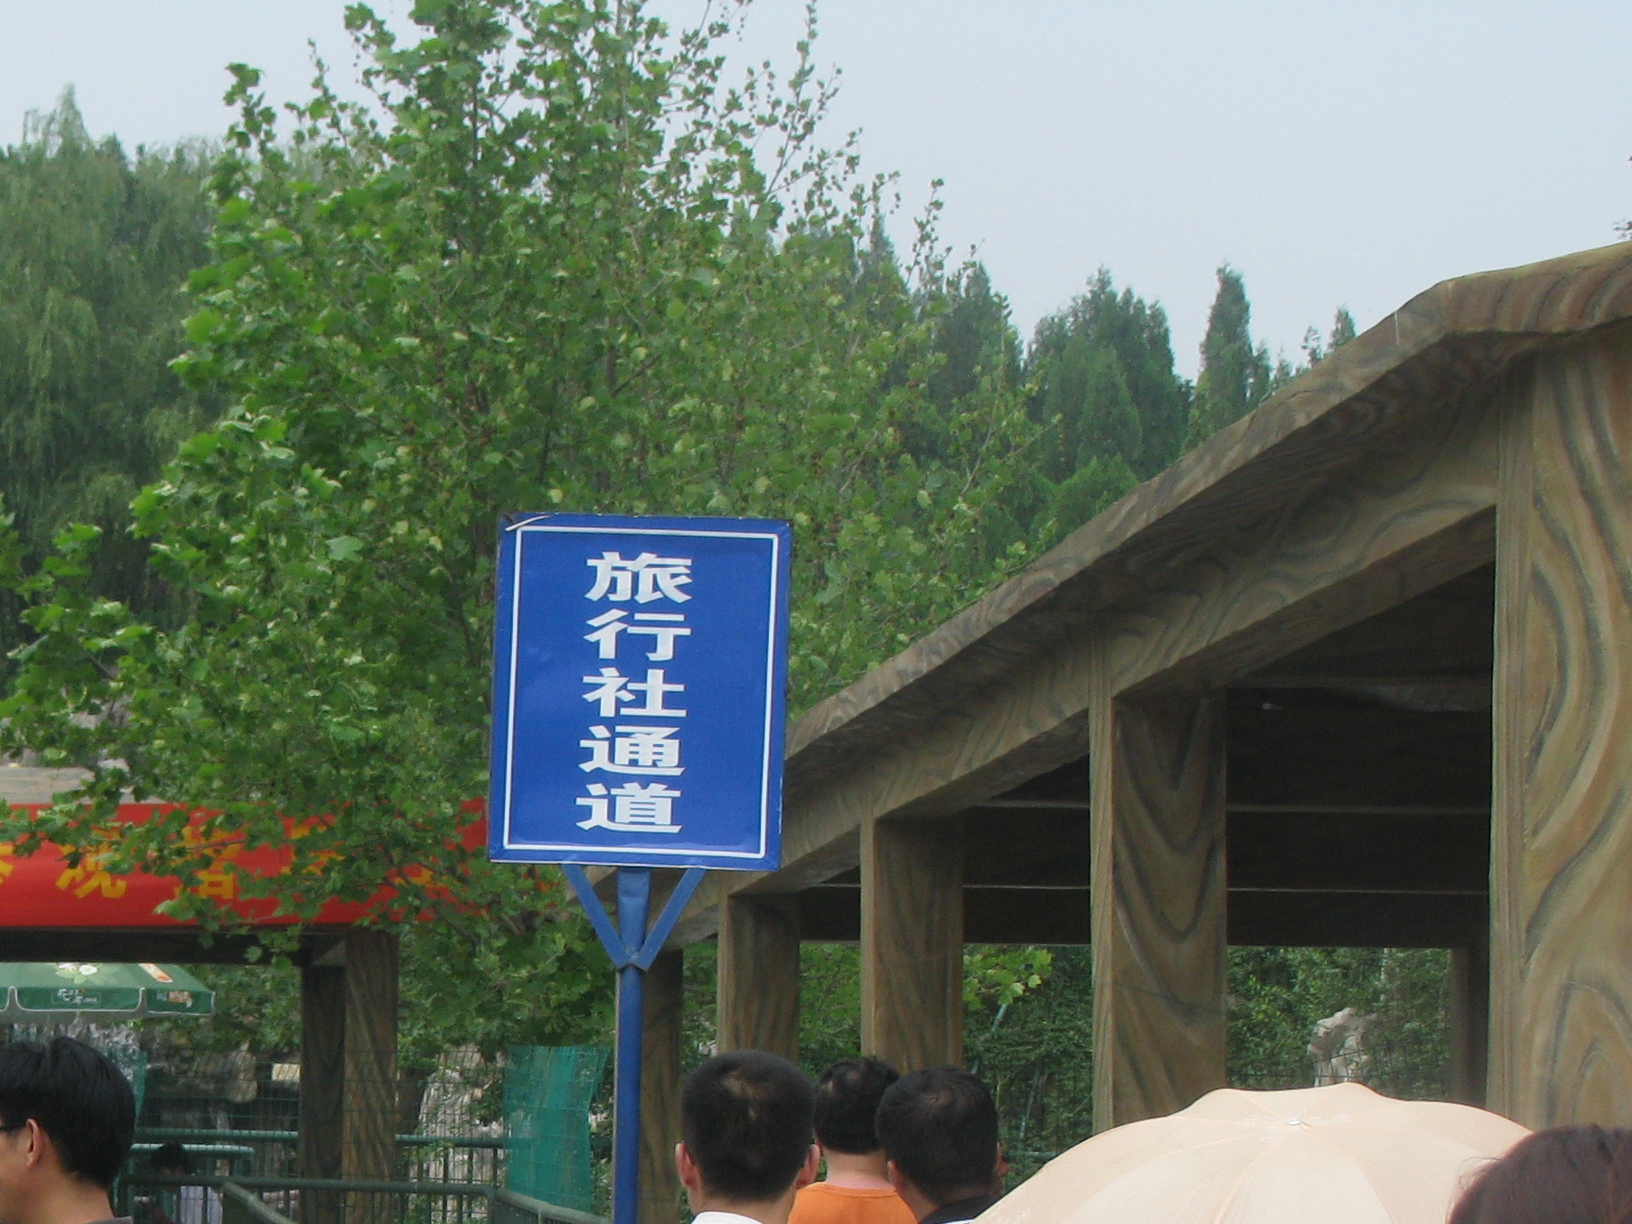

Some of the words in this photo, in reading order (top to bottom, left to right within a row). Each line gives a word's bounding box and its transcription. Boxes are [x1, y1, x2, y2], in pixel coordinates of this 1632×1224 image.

[575, 551, 693, 834] 旅行社通道
